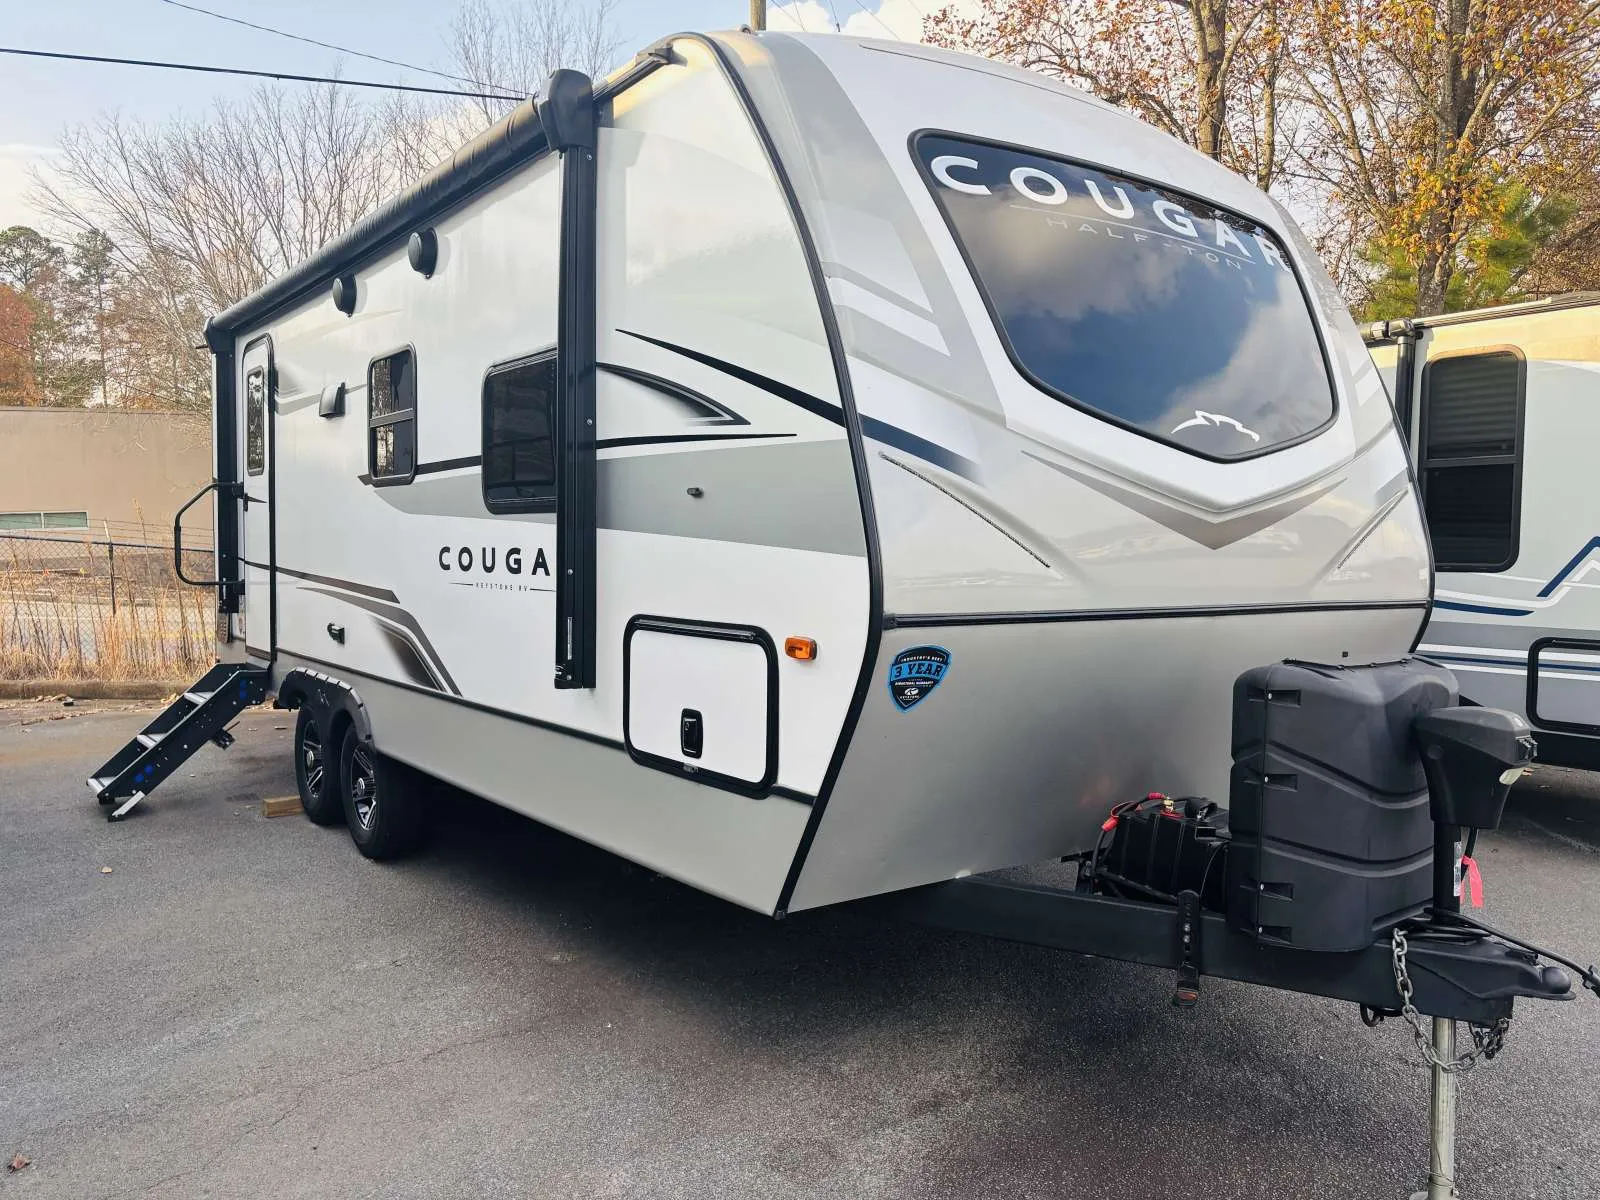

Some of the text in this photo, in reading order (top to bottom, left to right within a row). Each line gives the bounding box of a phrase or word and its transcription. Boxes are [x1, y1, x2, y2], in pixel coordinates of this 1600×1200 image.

[930, 155, 1291, 272] COUGAR
[438, 546, 551, 576] COUGA
[894, 663, 943, 678] 3 YEAR
